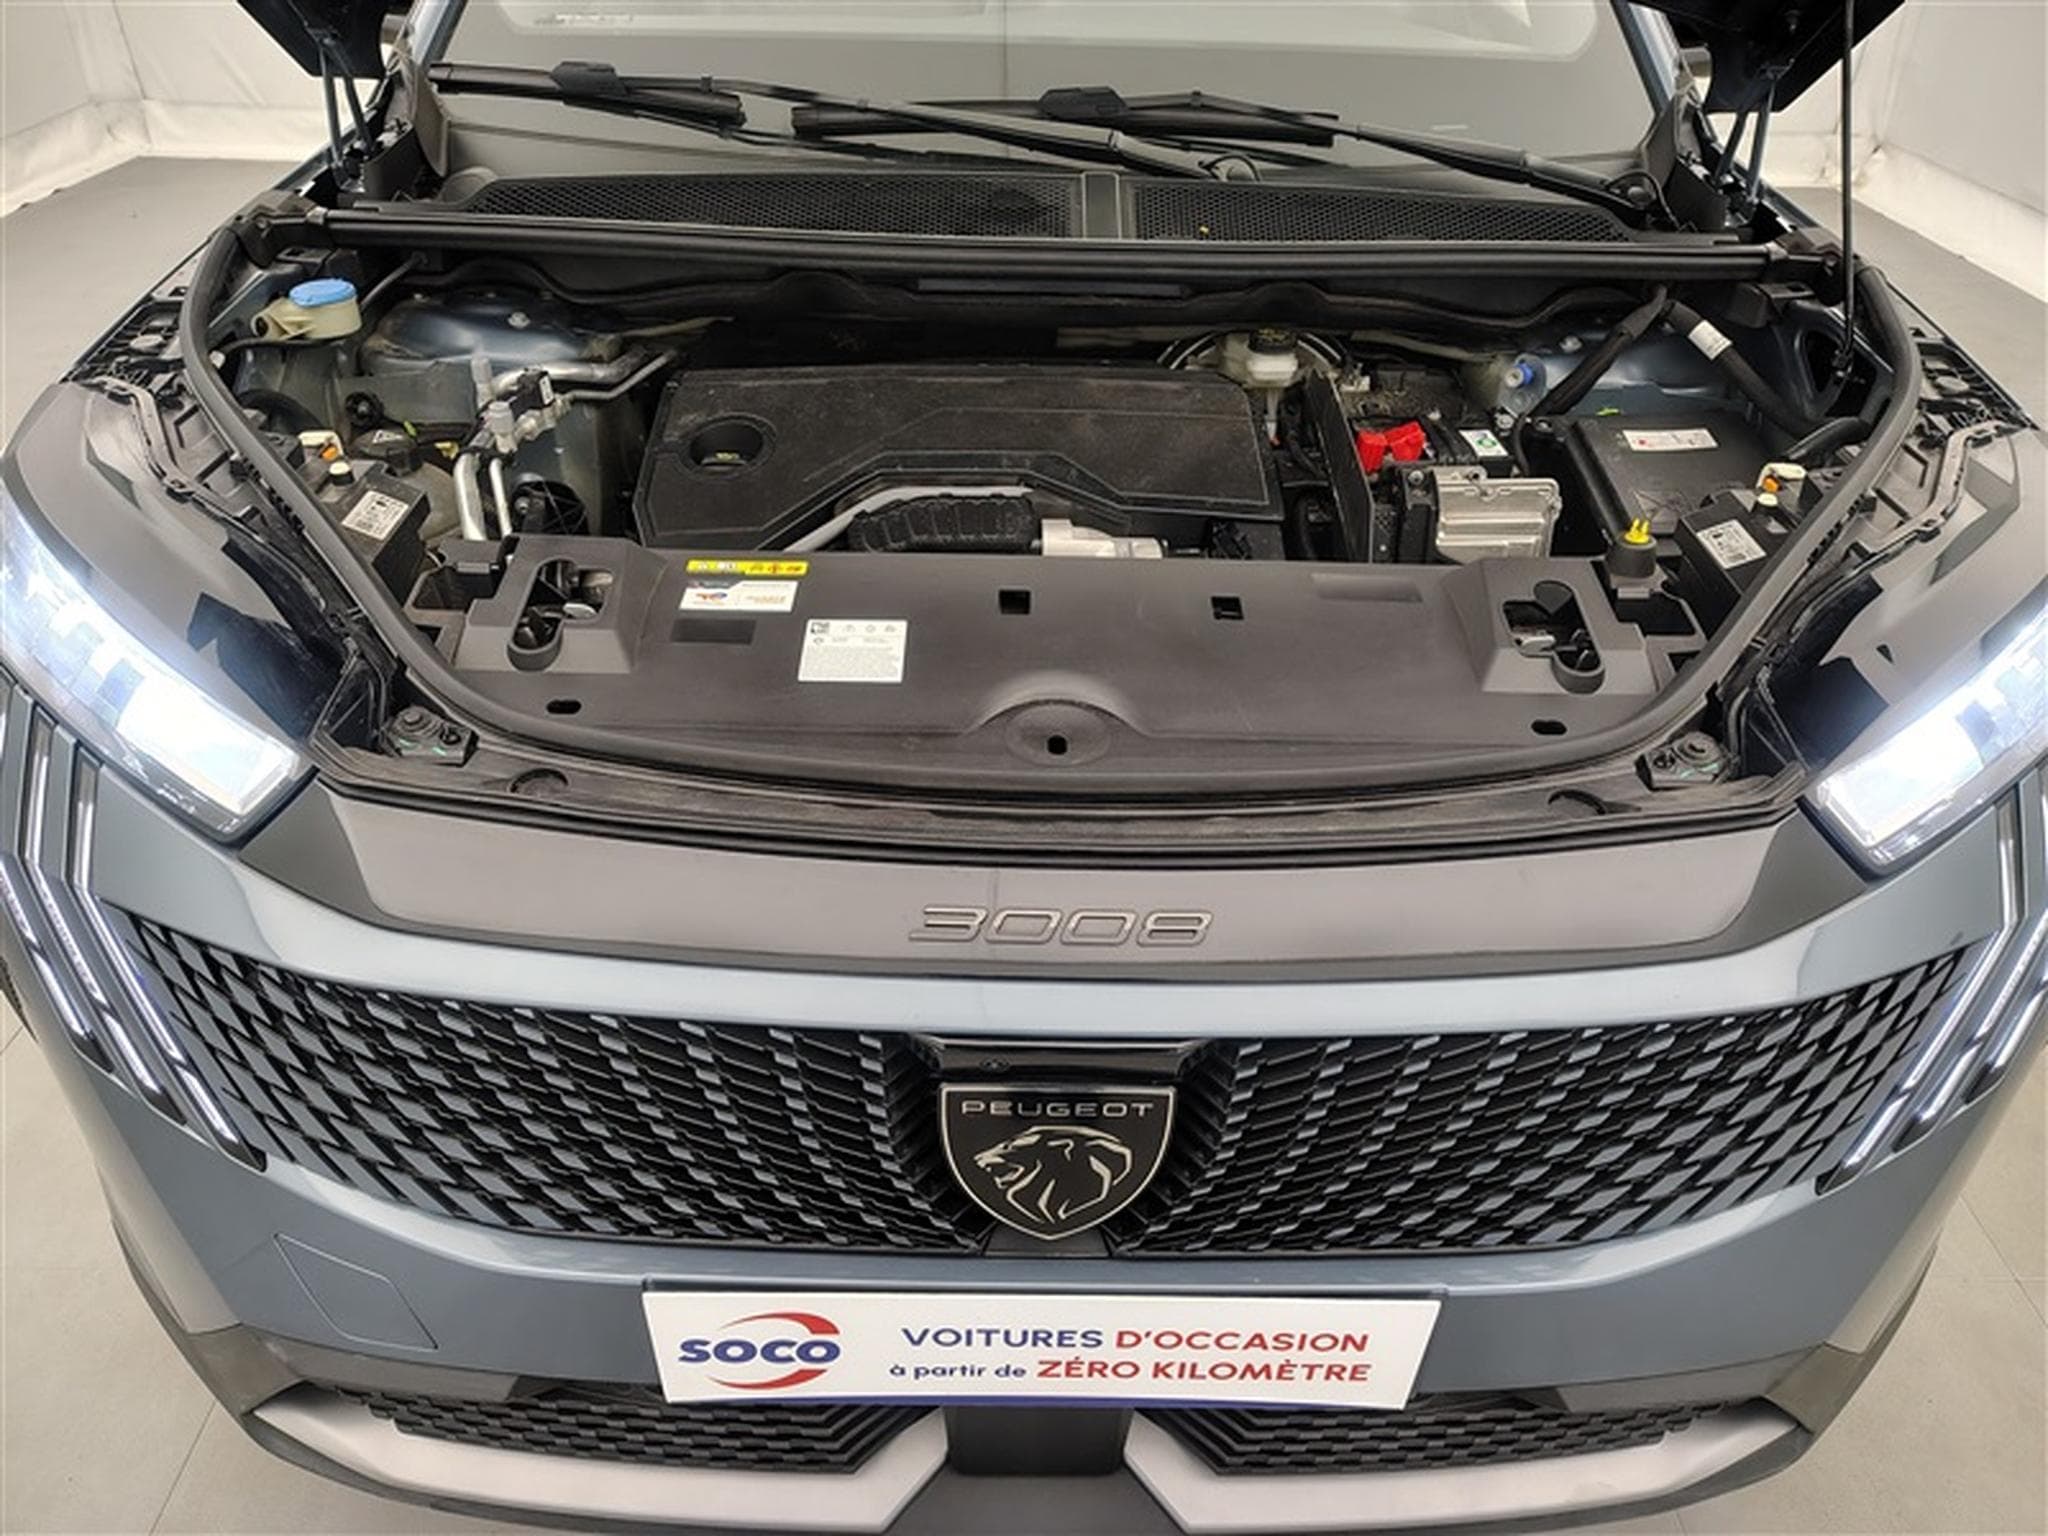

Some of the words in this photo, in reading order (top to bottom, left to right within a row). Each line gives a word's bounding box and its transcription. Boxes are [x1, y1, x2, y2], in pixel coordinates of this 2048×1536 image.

[908, 907, 1213, 947] 3008
[961, 1101, 1154, 1118] PEUGEOT
[678, 1339, 841, 1364] SOCO
[902, 1327, 1103, 1348] VOITURES
[1115, 1330, 1369, 1352] D'OCCASION
[889, 1363, 906, 1377] à
[913, 1364, 986, 1380] partir
[995, 1364, 1027, 1377] de
[1037, 1356, 1141, 1379] ZÉRO
[1152, 1359, 1372, 1381] KILOMÈTRE
